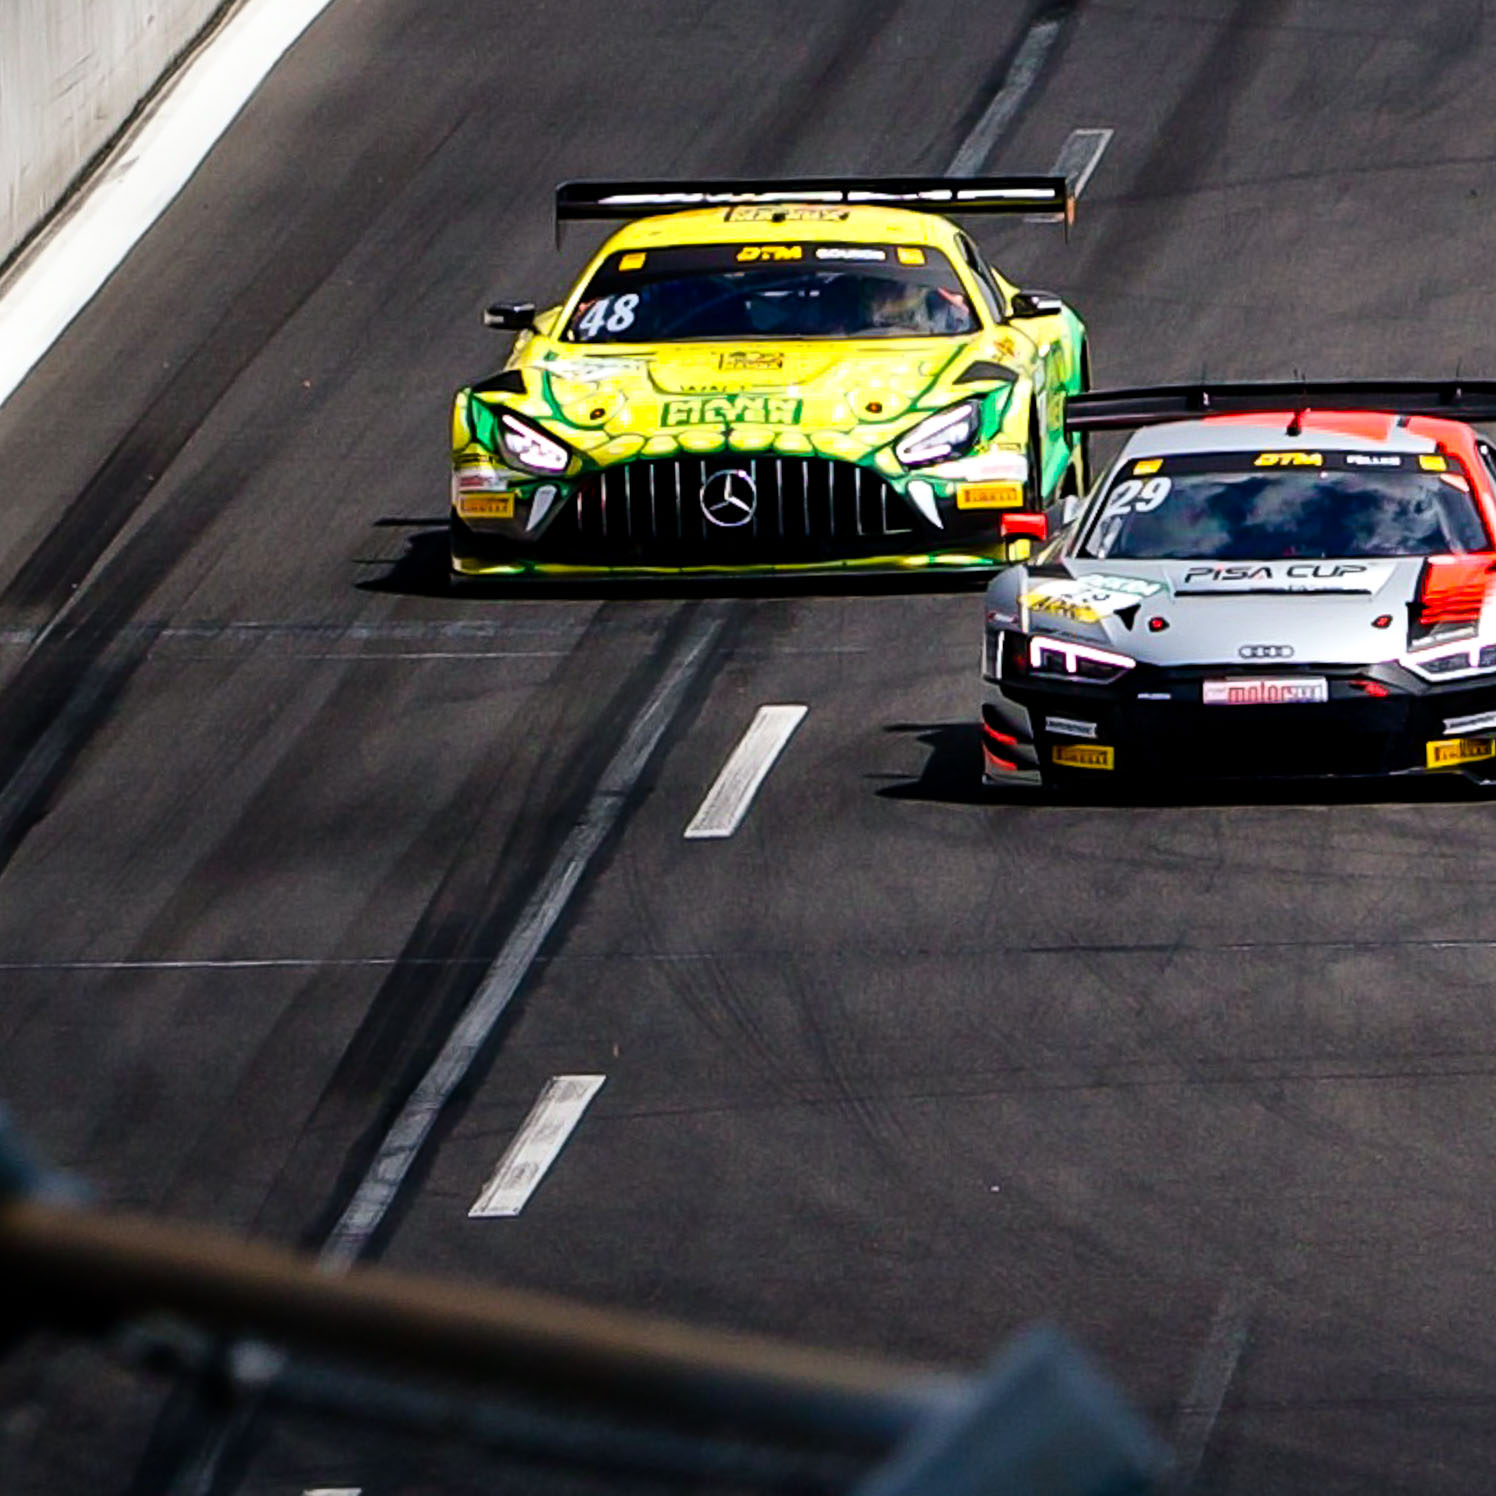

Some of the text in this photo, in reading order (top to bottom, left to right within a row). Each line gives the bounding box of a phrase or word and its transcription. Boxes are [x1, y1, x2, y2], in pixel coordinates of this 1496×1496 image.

[736, 246, 802, 261] DTM
[579, 292, 640, 336] 48
[1254, 452, 1323, 466] DTM
[1110, 476, 1172, 513] 29
[1286, 564, 1367, 578] CUP
